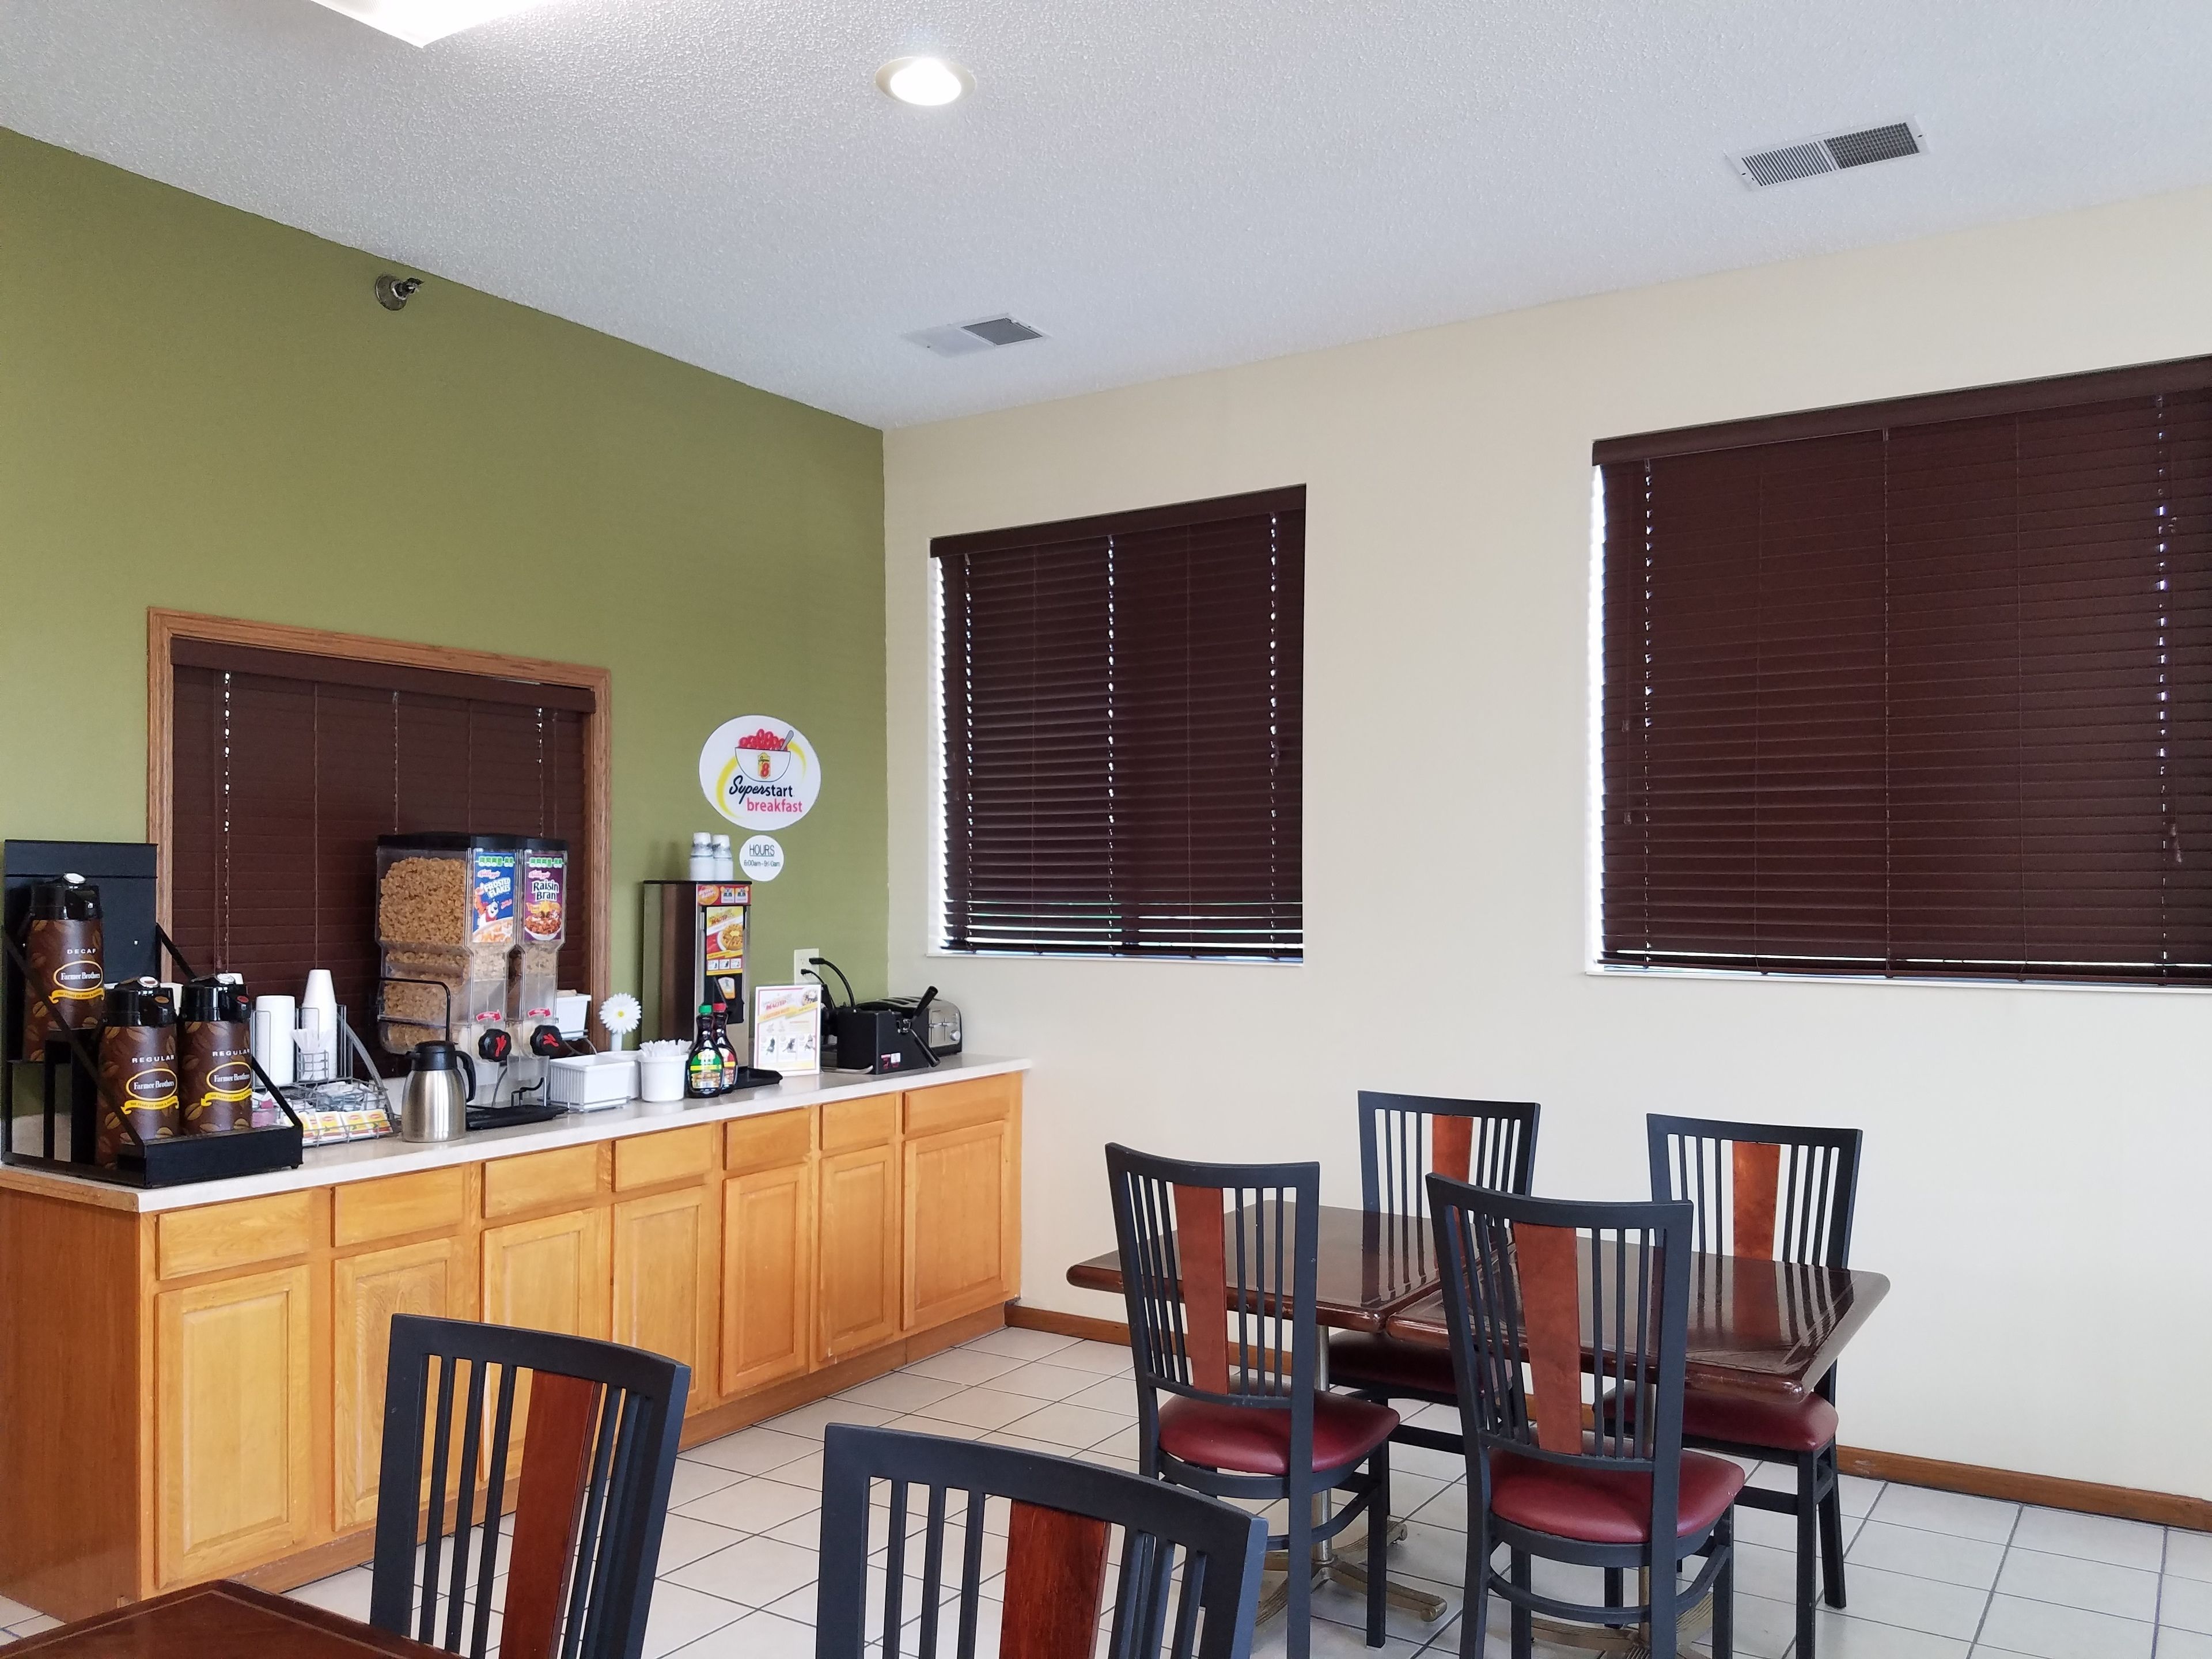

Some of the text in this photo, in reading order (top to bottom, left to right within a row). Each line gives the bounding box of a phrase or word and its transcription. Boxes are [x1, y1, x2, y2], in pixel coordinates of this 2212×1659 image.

[761, 762, 770, 777] 8
[729, 775, 793, 805] Superstart
[747, 797, 802, 813] breakfast
[749, 844, 775, 856] HOURS
[532, 880, 559, 892] Raisin
[536, 891, 556, 900] Bran
[60, 971, 101, 980] Farmer Brothers
[211, 1048, 250, 1056] REGULAR
[131, 1055, 175, 1063] REGULAR
[214, 1074, 233, 1082] Farmer
[134, 1080, 175, 1090] Farmer Brothers
